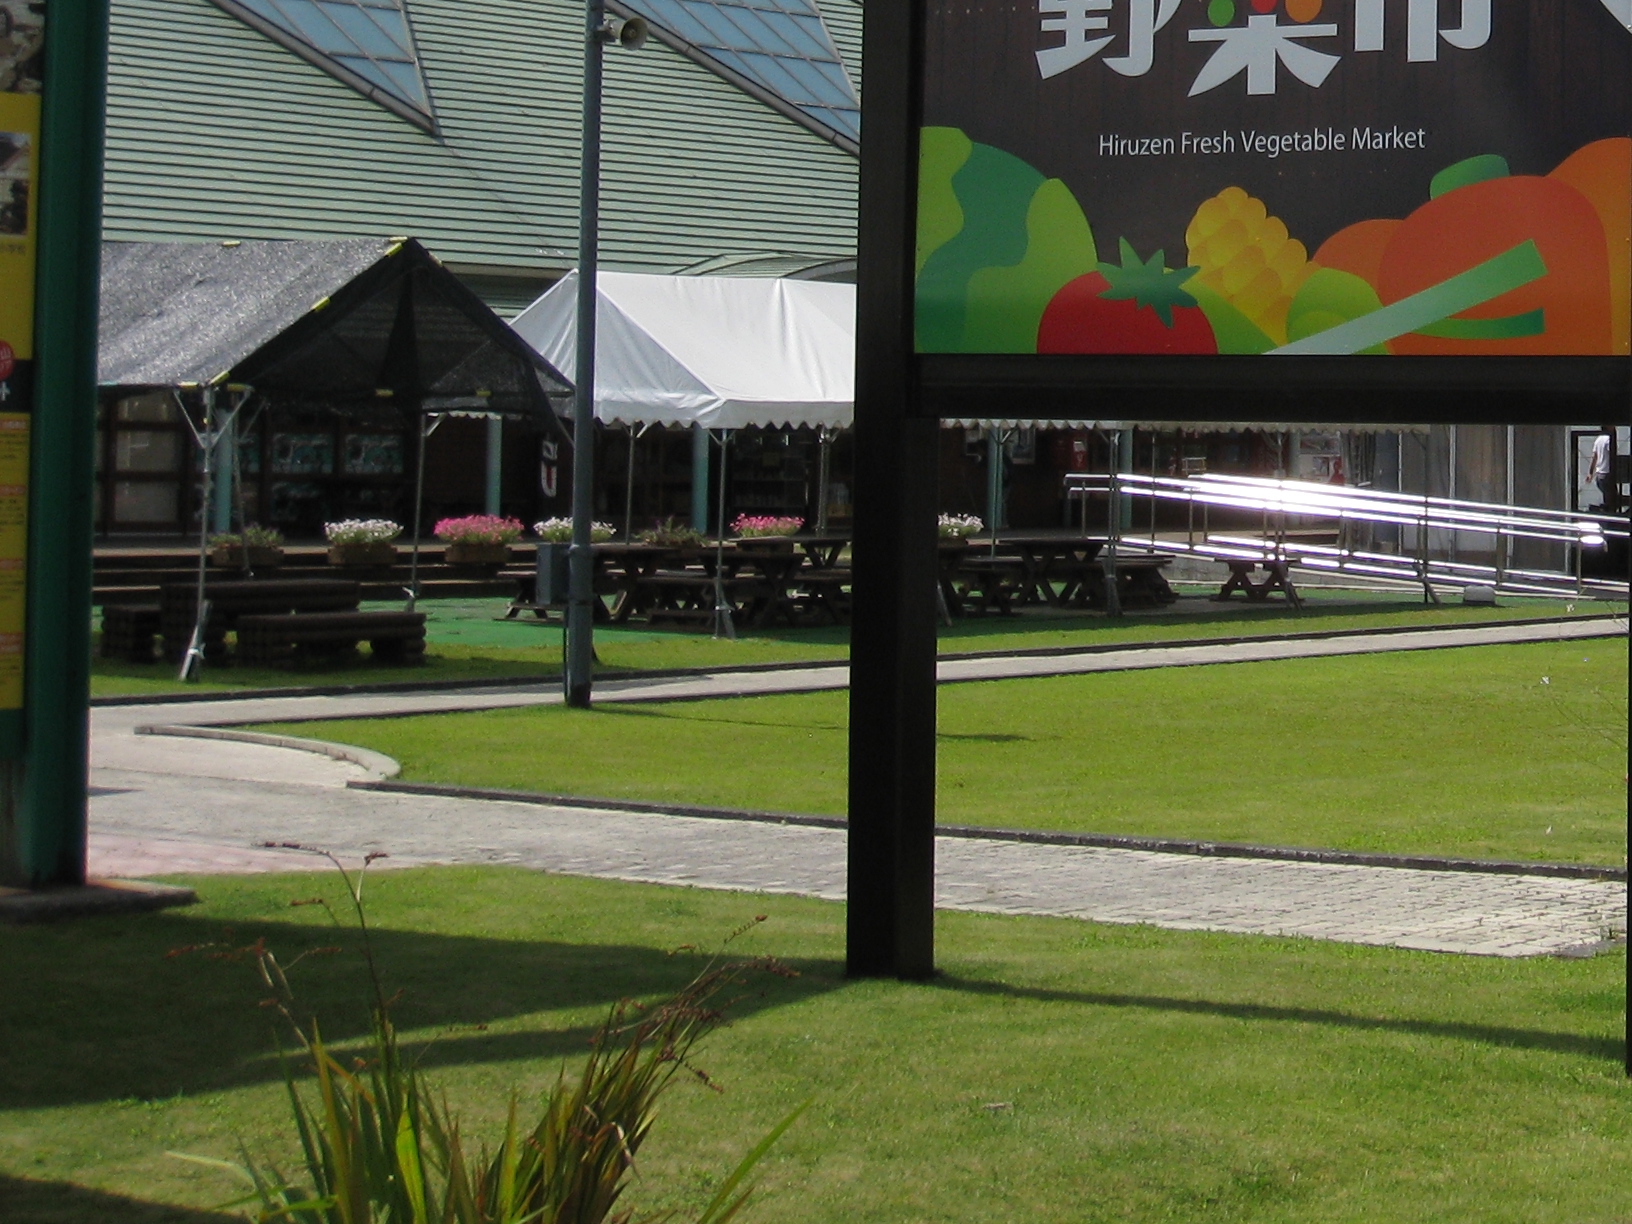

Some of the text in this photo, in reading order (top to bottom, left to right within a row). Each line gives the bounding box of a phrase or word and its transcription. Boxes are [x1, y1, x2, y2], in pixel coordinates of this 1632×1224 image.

[1099, 126, 1426, 159] Hiruzen Fresh Vegetable Market
